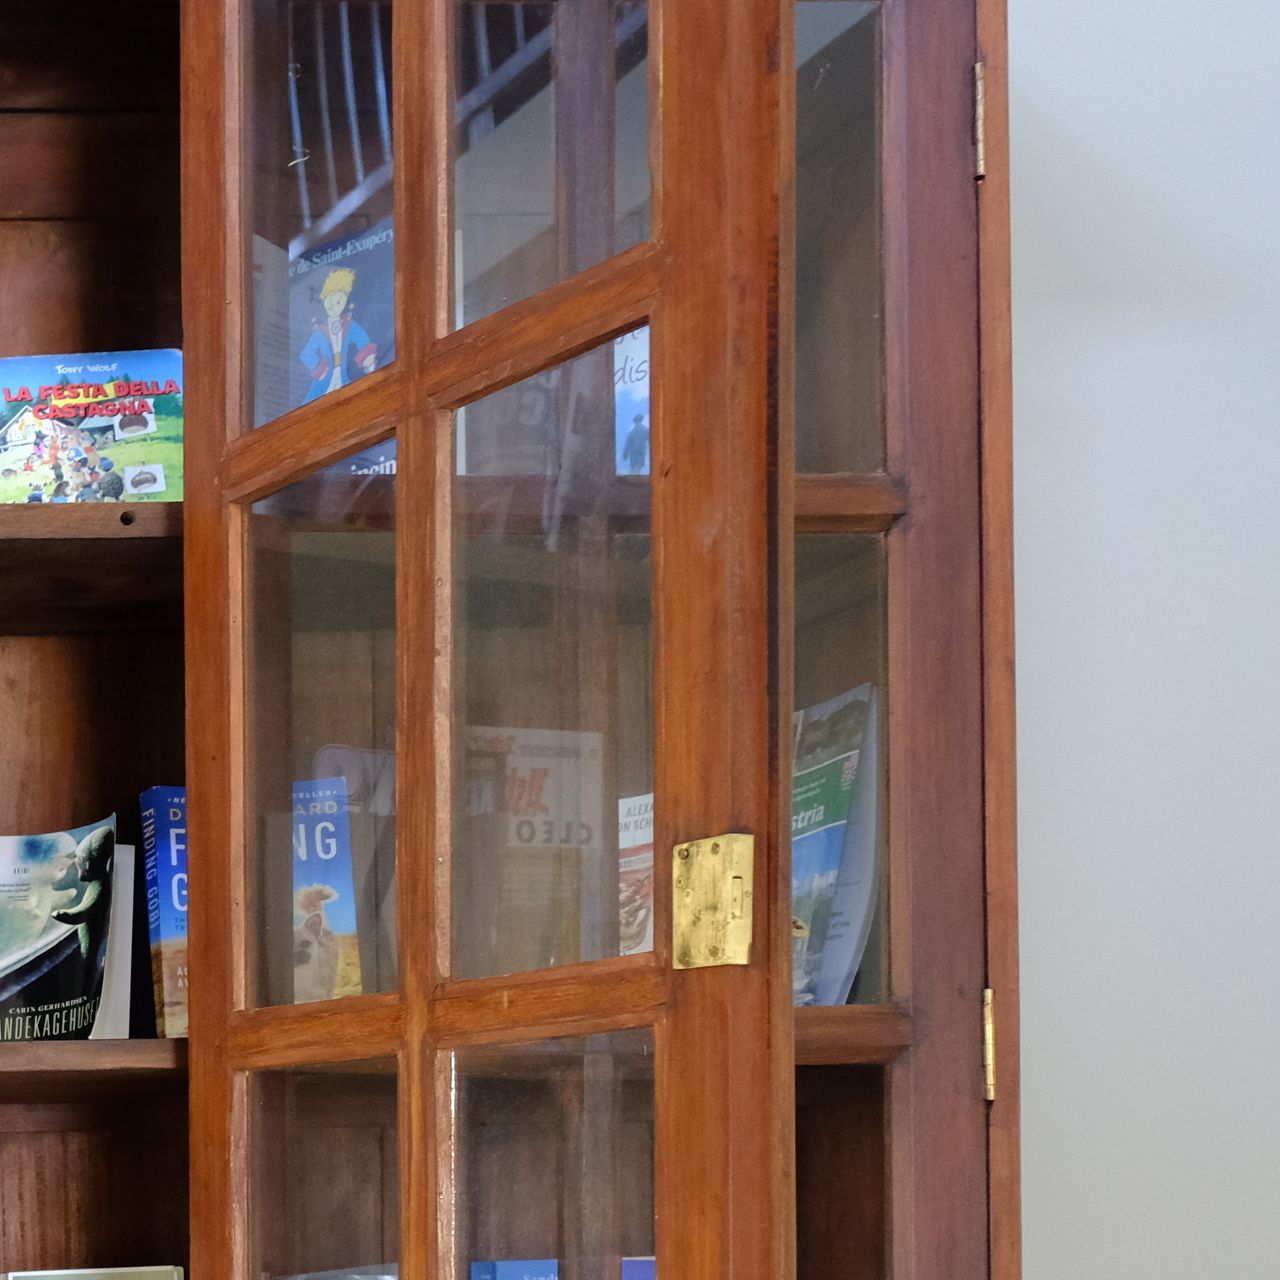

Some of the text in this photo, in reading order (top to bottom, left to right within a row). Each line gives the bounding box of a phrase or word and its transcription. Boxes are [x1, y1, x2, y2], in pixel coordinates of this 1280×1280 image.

[2, 378, 181, 403] LA FESTA DELLA
[32, 399, 155, 420] CASTAGNA
[633, 818, 653, 832] SCH
[142, 807, 159, 881] FINDING
[146, 885, 161, 930] GOBI
